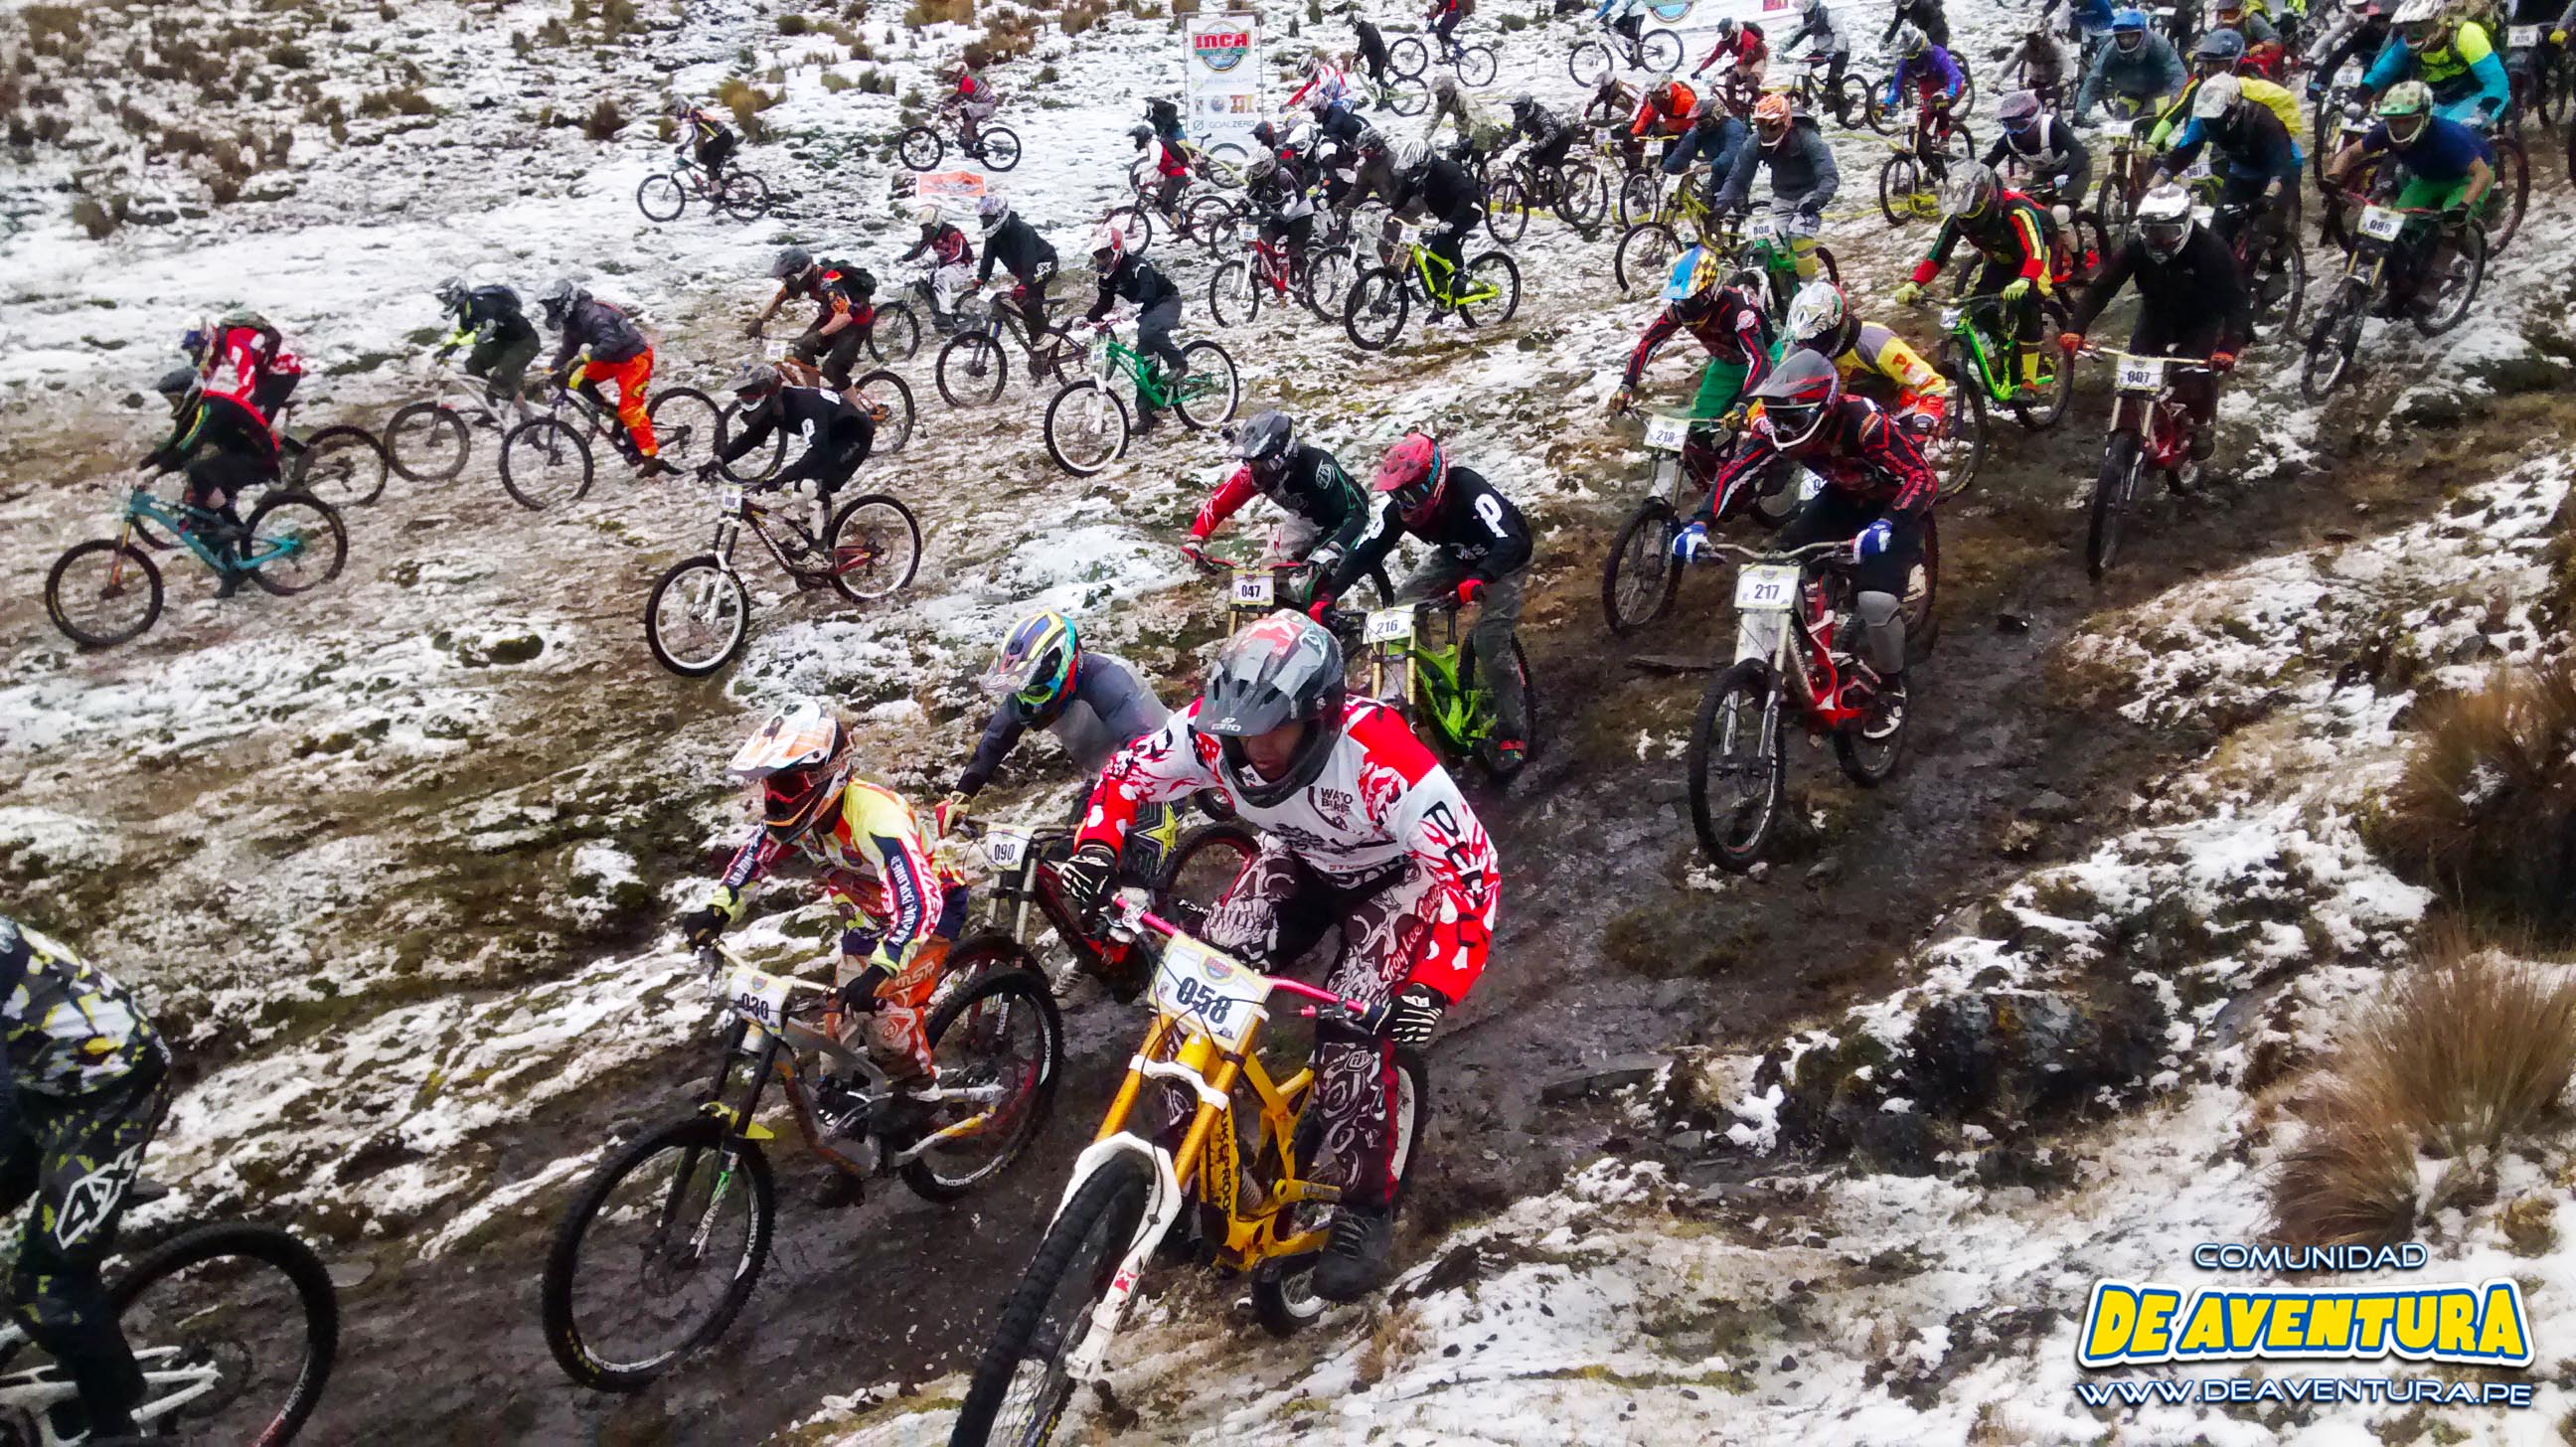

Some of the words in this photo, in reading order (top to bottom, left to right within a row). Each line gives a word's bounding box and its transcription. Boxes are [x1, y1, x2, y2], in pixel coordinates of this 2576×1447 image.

[1196, 33, 1248, 48] INCA
[1656, 429, 1676, 443] 218
[1241, 584, 1261, 598] 047
[1754, 583, 1780, 599] 217
[1375, 619, 1399, 634] 216
[1210, 723, 1242, 733] GIRO
[994, 843, 1017, 863] 090
[1381, 953, 1409, 982] Troy
[1402, 924, 1424, 952] Lee
[1176, 976, 1232, 1024] 058
